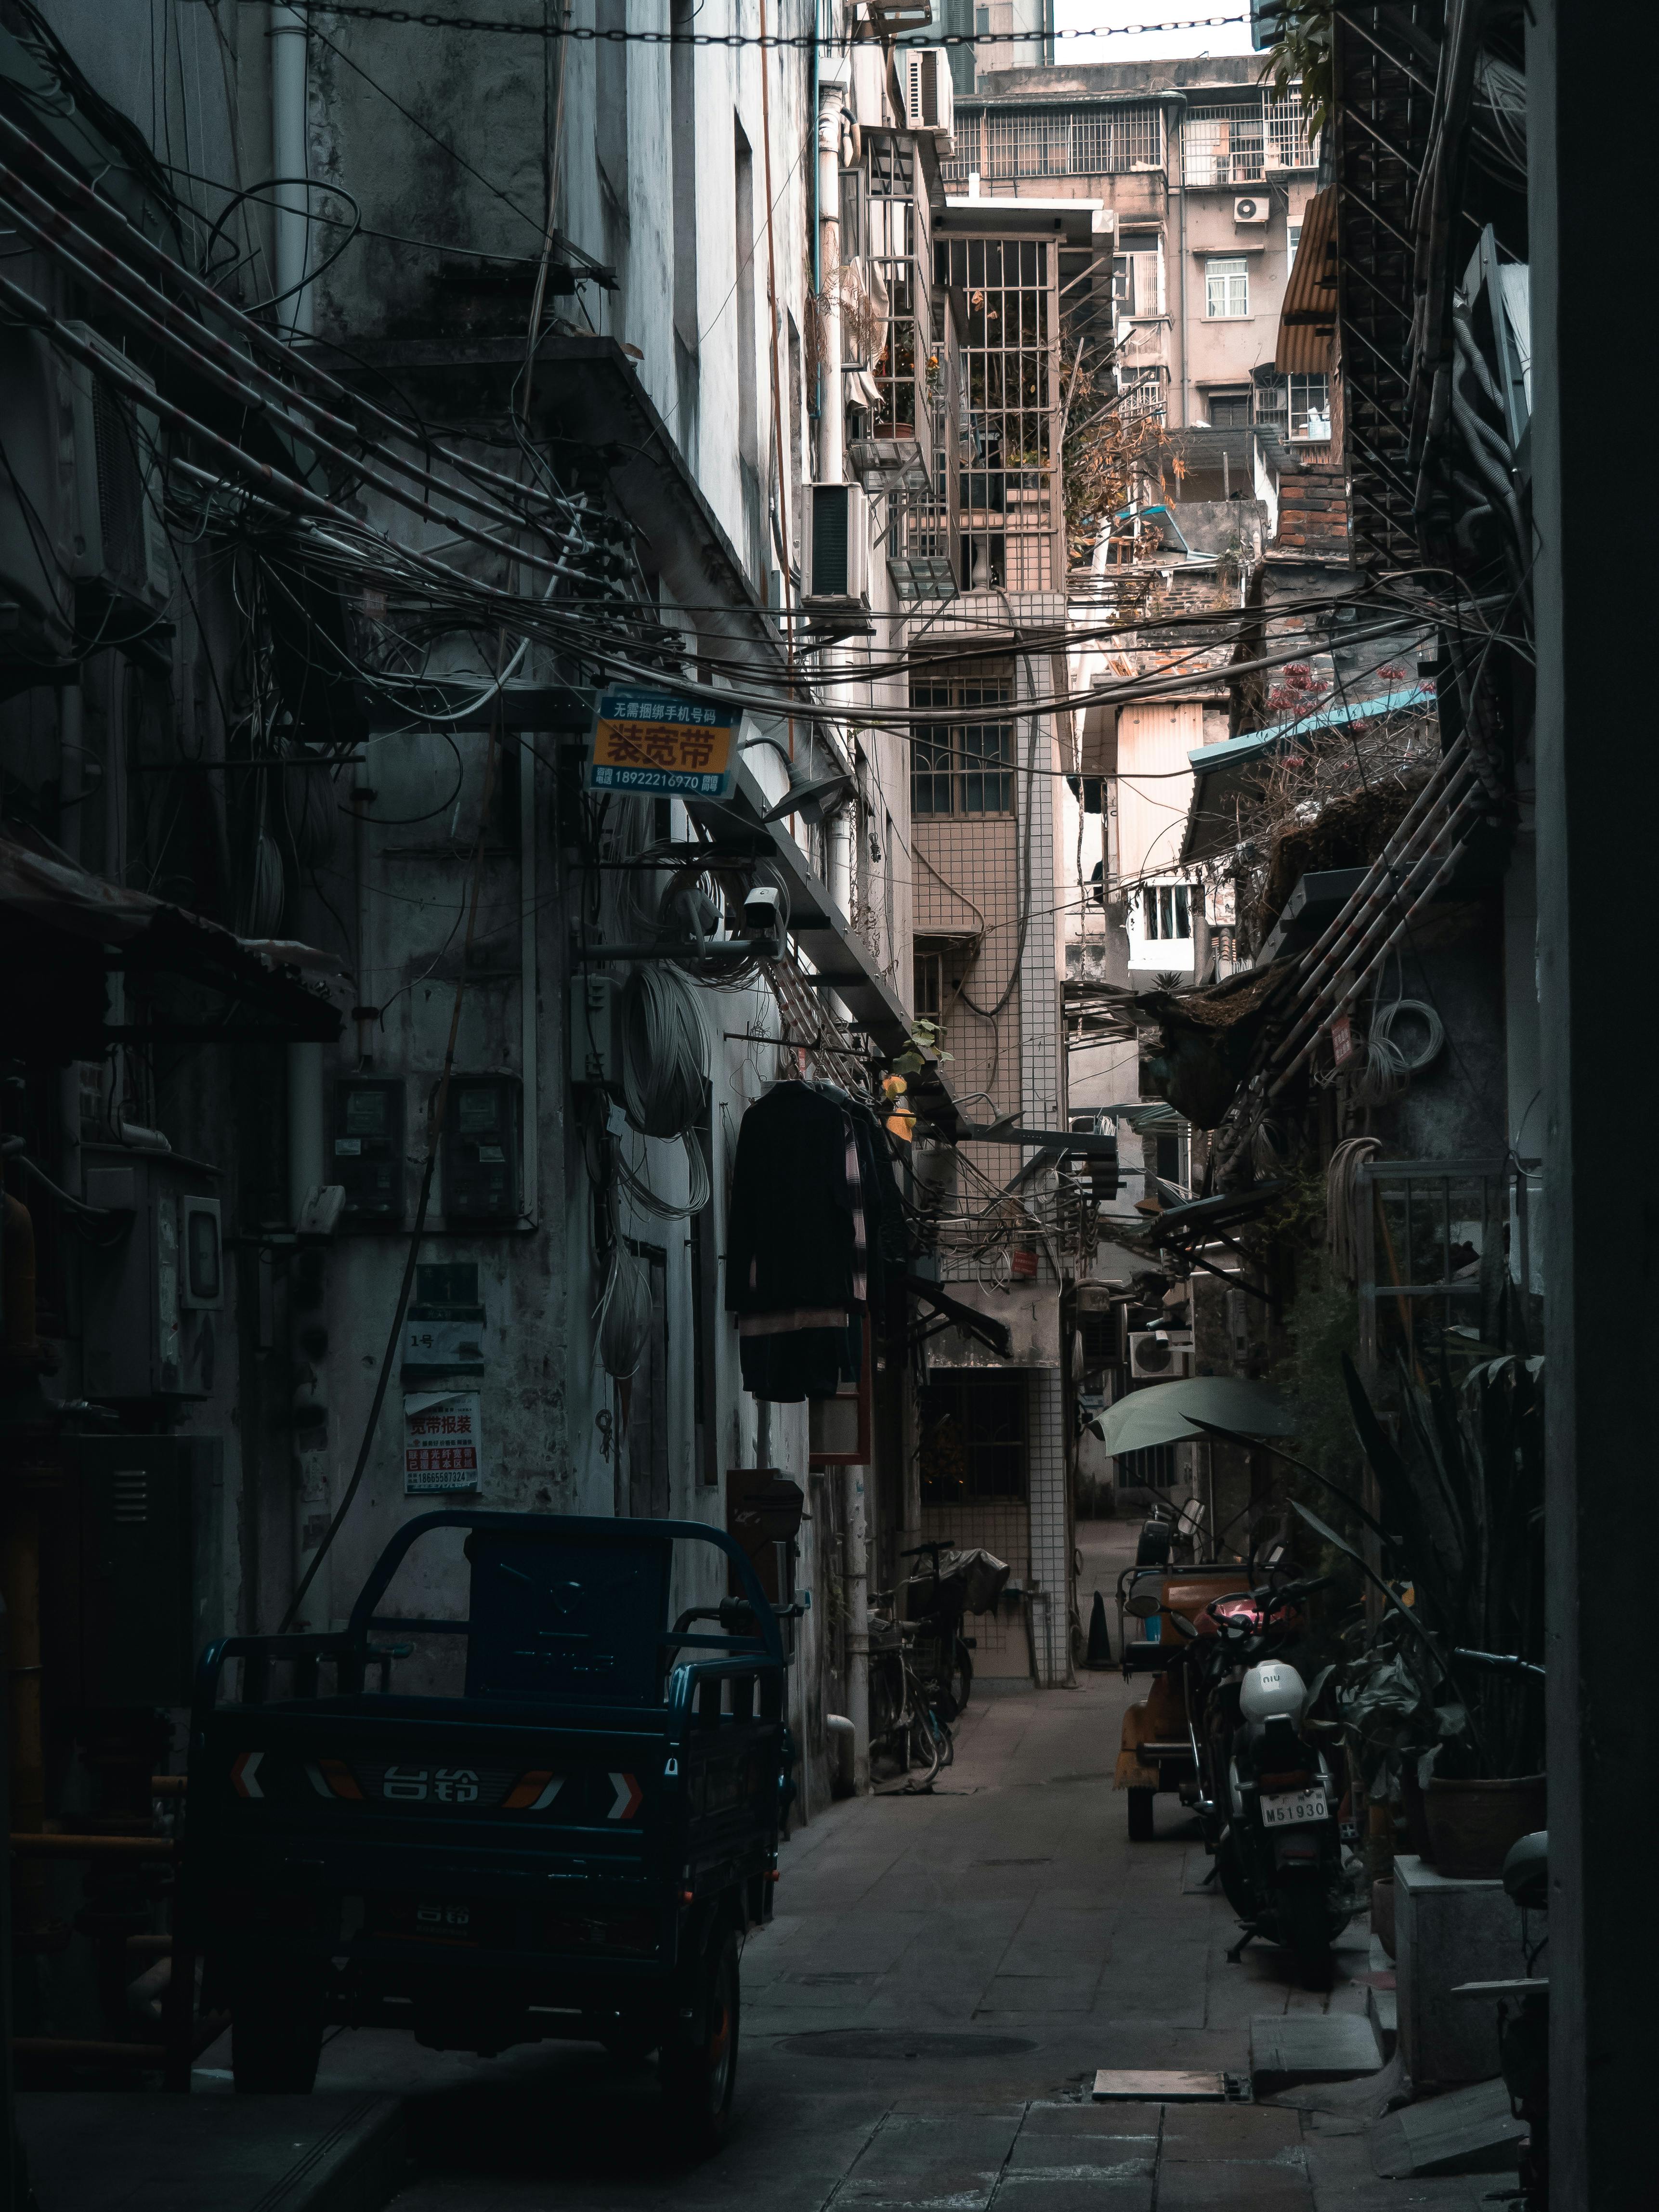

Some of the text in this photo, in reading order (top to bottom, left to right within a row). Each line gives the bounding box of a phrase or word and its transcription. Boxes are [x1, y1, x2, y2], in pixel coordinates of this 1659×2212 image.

[614, 702, 716, 724] 无需捆绑手机号码
[607, 724, 715, 768] 装宽带
[615, 771, 698, 788] 18922216970
[411, 1334, 433, 1348] 1号
[411, 1415, 472, 1435] 宽带报装
[383, 1766, 480, 1802] 台铃
[1266, 1803, 1324, 1822] M51930
